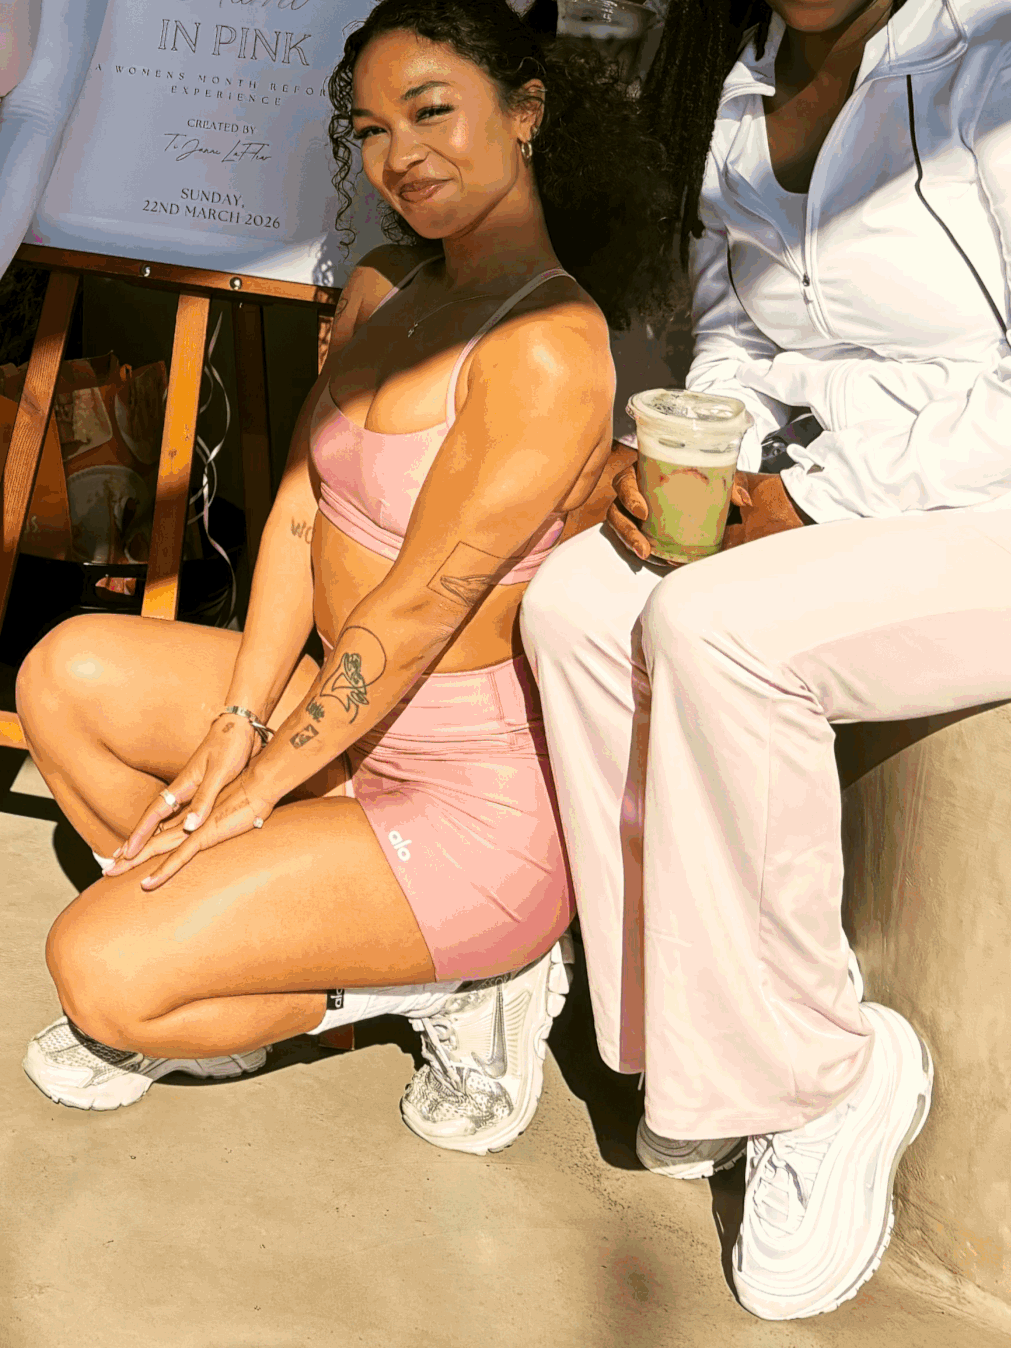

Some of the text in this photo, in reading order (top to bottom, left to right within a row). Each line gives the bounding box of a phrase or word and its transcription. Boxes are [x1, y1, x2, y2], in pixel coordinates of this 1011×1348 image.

[158, 19, 312, 66] IN PINK
[95, 63, 326, 97] A WOMENS MONTH REFOR
[171, 85, 281, 106] EXPERIENCE
[187, 118, 256, 135] CREATED BY
[180, 187, 245, 209] SUNDAY,
[142, 199, 281, 229] 22ND MARCH 2026
[388, 830, 412, 862] alo
